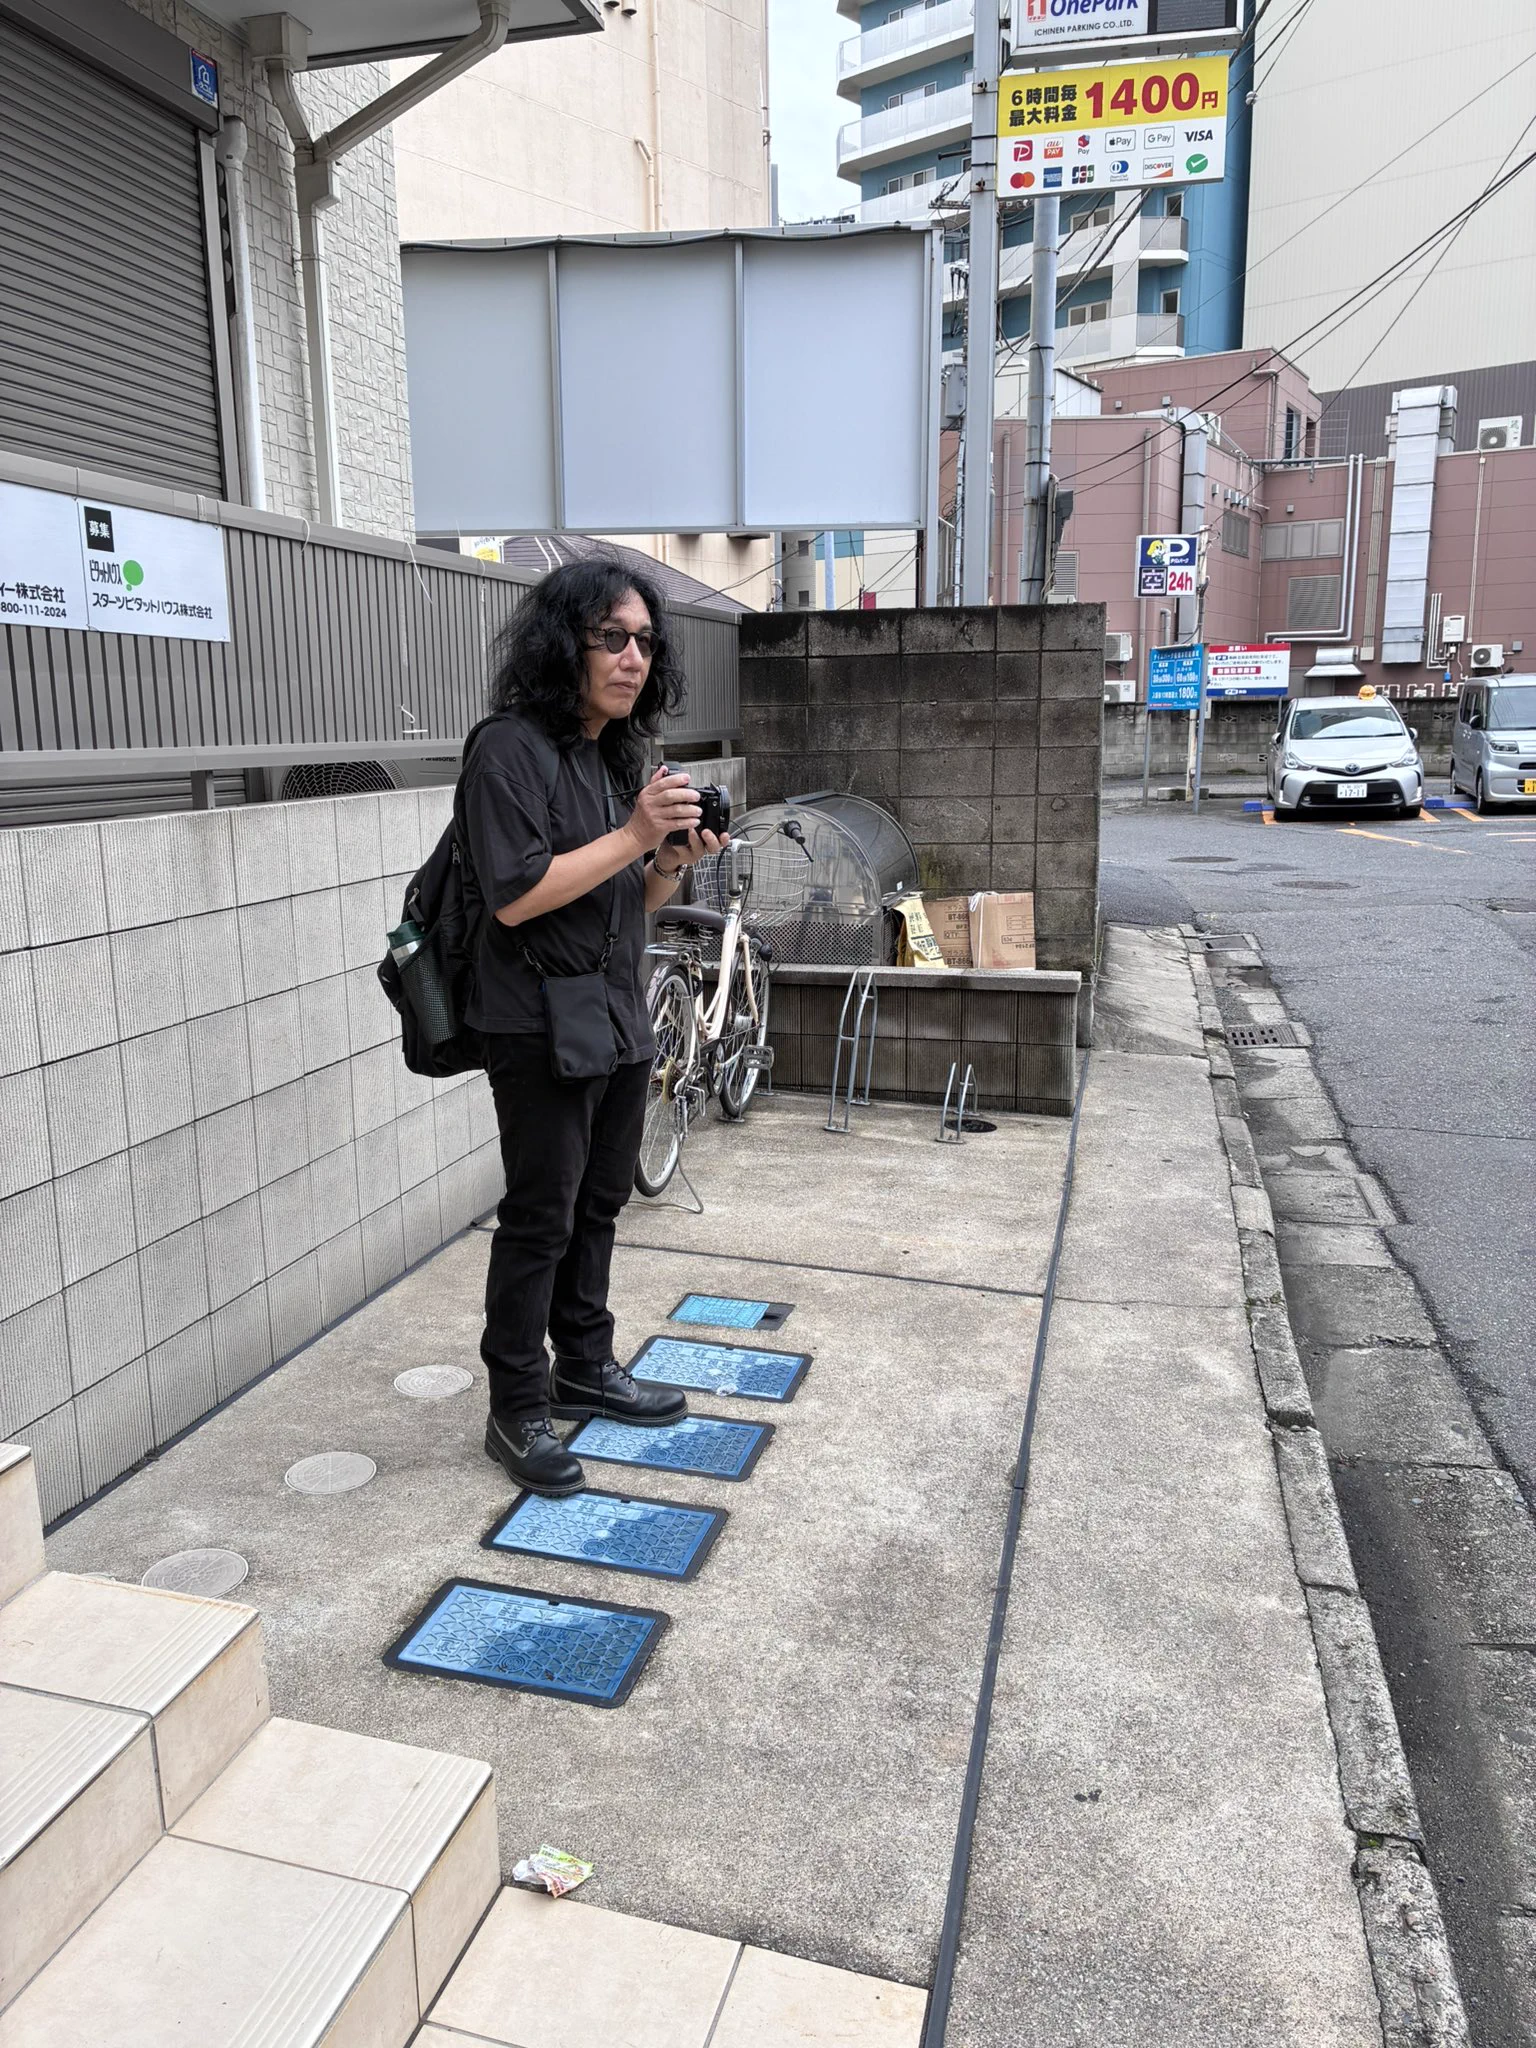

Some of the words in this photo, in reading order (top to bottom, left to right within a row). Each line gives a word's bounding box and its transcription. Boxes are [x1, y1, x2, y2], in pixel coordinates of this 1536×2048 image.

[1034, 26, 1065, 36] ICHINEN
[1067, 22, 1101, 33] PARKING
[1011, 84, 1077, 106] 6時間毎
[1009, 104, 1077, 127] 最大料金
[1115, 137, 1132, 147] Pay
[1184, 129, 1214, 143] VISA
[1047, 148, 1060, 156] PAY
[88, 520, 111, 539] 募集
[1168, 571, 1193, 591] 24h
[92, 592, 213, 620] スターツピタットハウス株式会社
